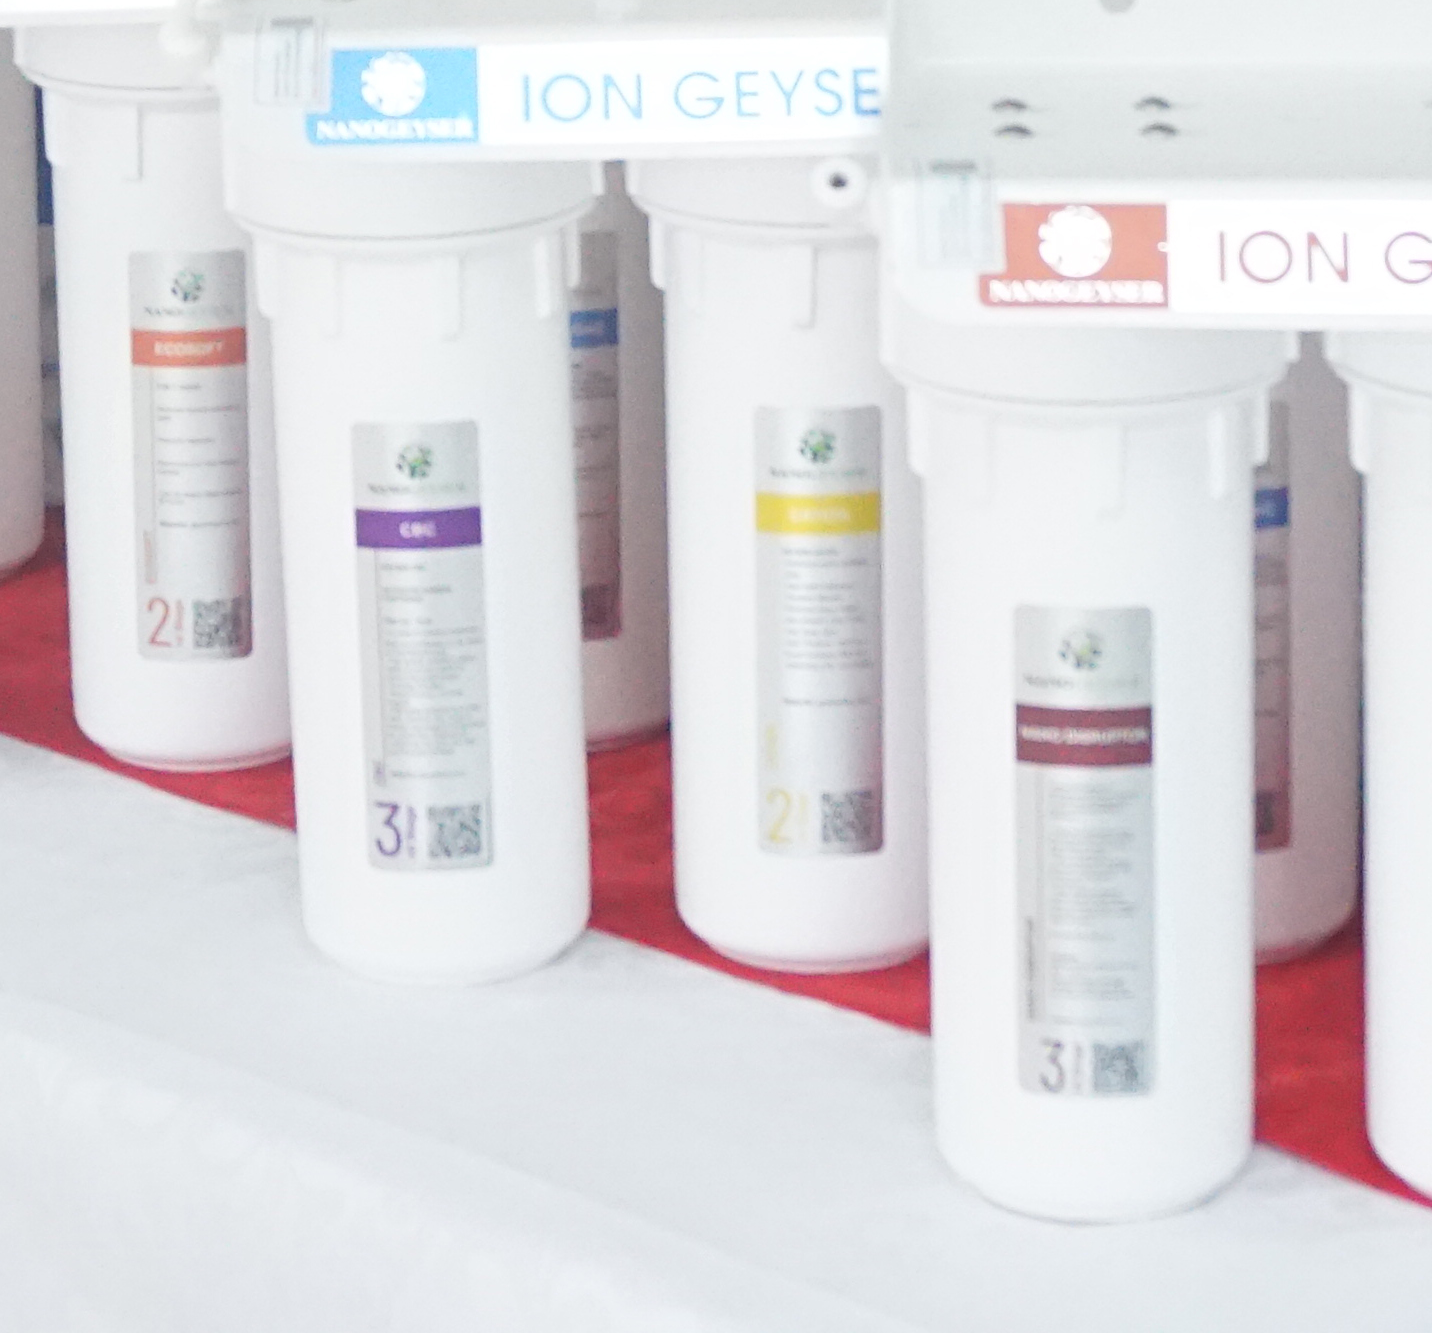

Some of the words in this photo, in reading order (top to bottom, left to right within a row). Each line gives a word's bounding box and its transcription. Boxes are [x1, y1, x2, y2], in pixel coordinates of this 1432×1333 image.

[522, 73, 643, 123] ION
[1218, 230, 1350, 284] ION
[146, 596, 173, 649] 2
[372, 800, 402, 858] 3
[1039, 1039, 1067, 1094] 3
